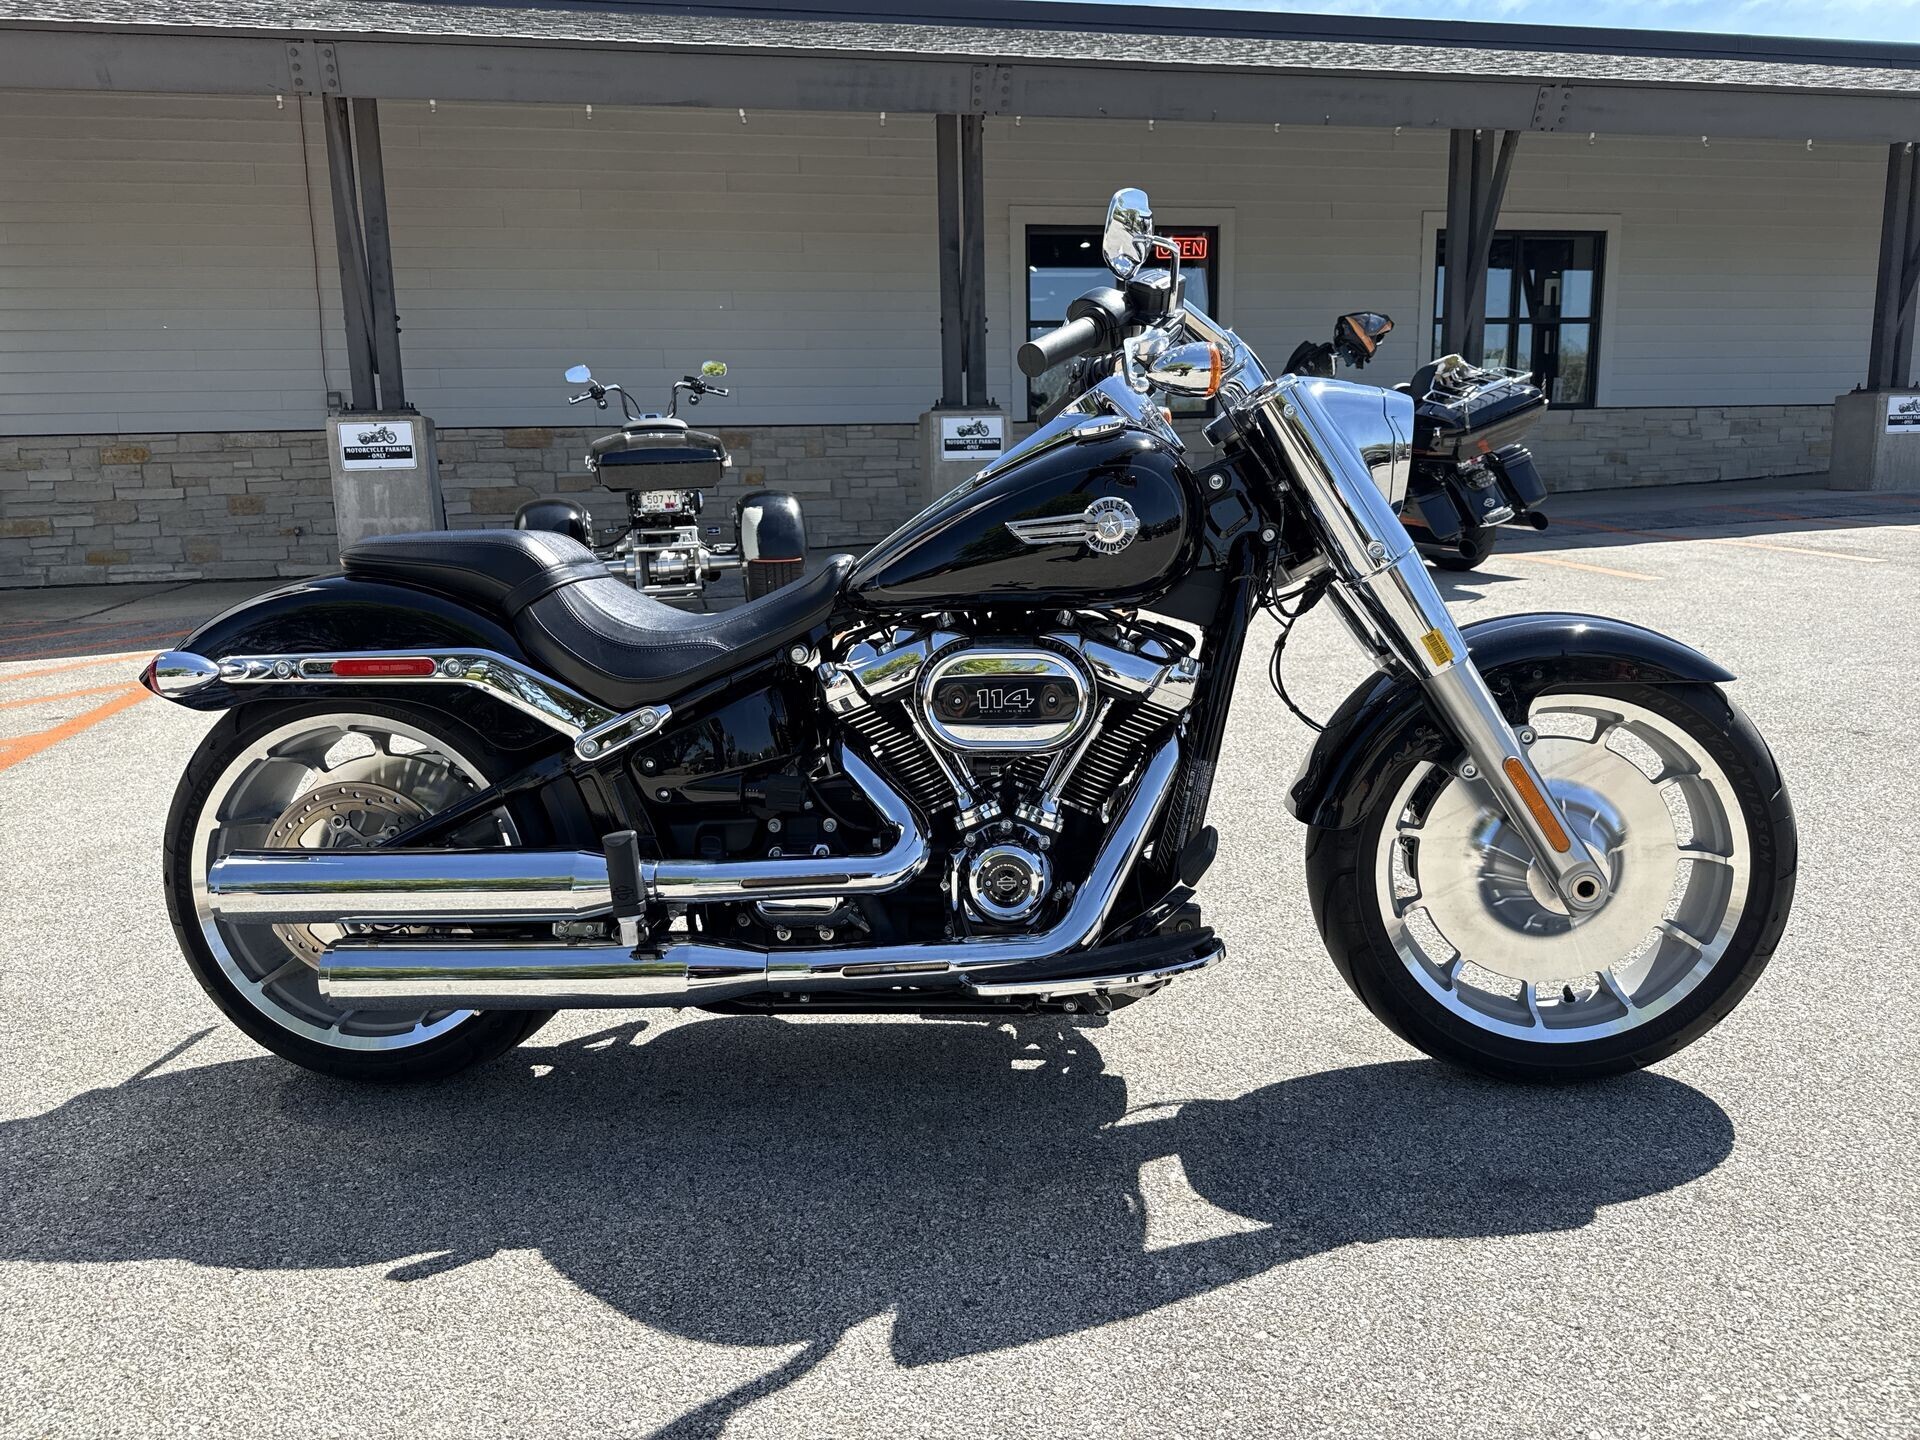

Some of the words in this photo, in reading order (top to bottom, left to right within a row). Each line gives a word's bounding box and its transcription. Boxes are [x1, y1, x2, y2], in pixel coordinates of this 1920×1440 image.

[647, 494, 664, 504] 507
[1088, 532, 1133, 551] DAVIDSON
[976, 688, 1035, 709] 114
